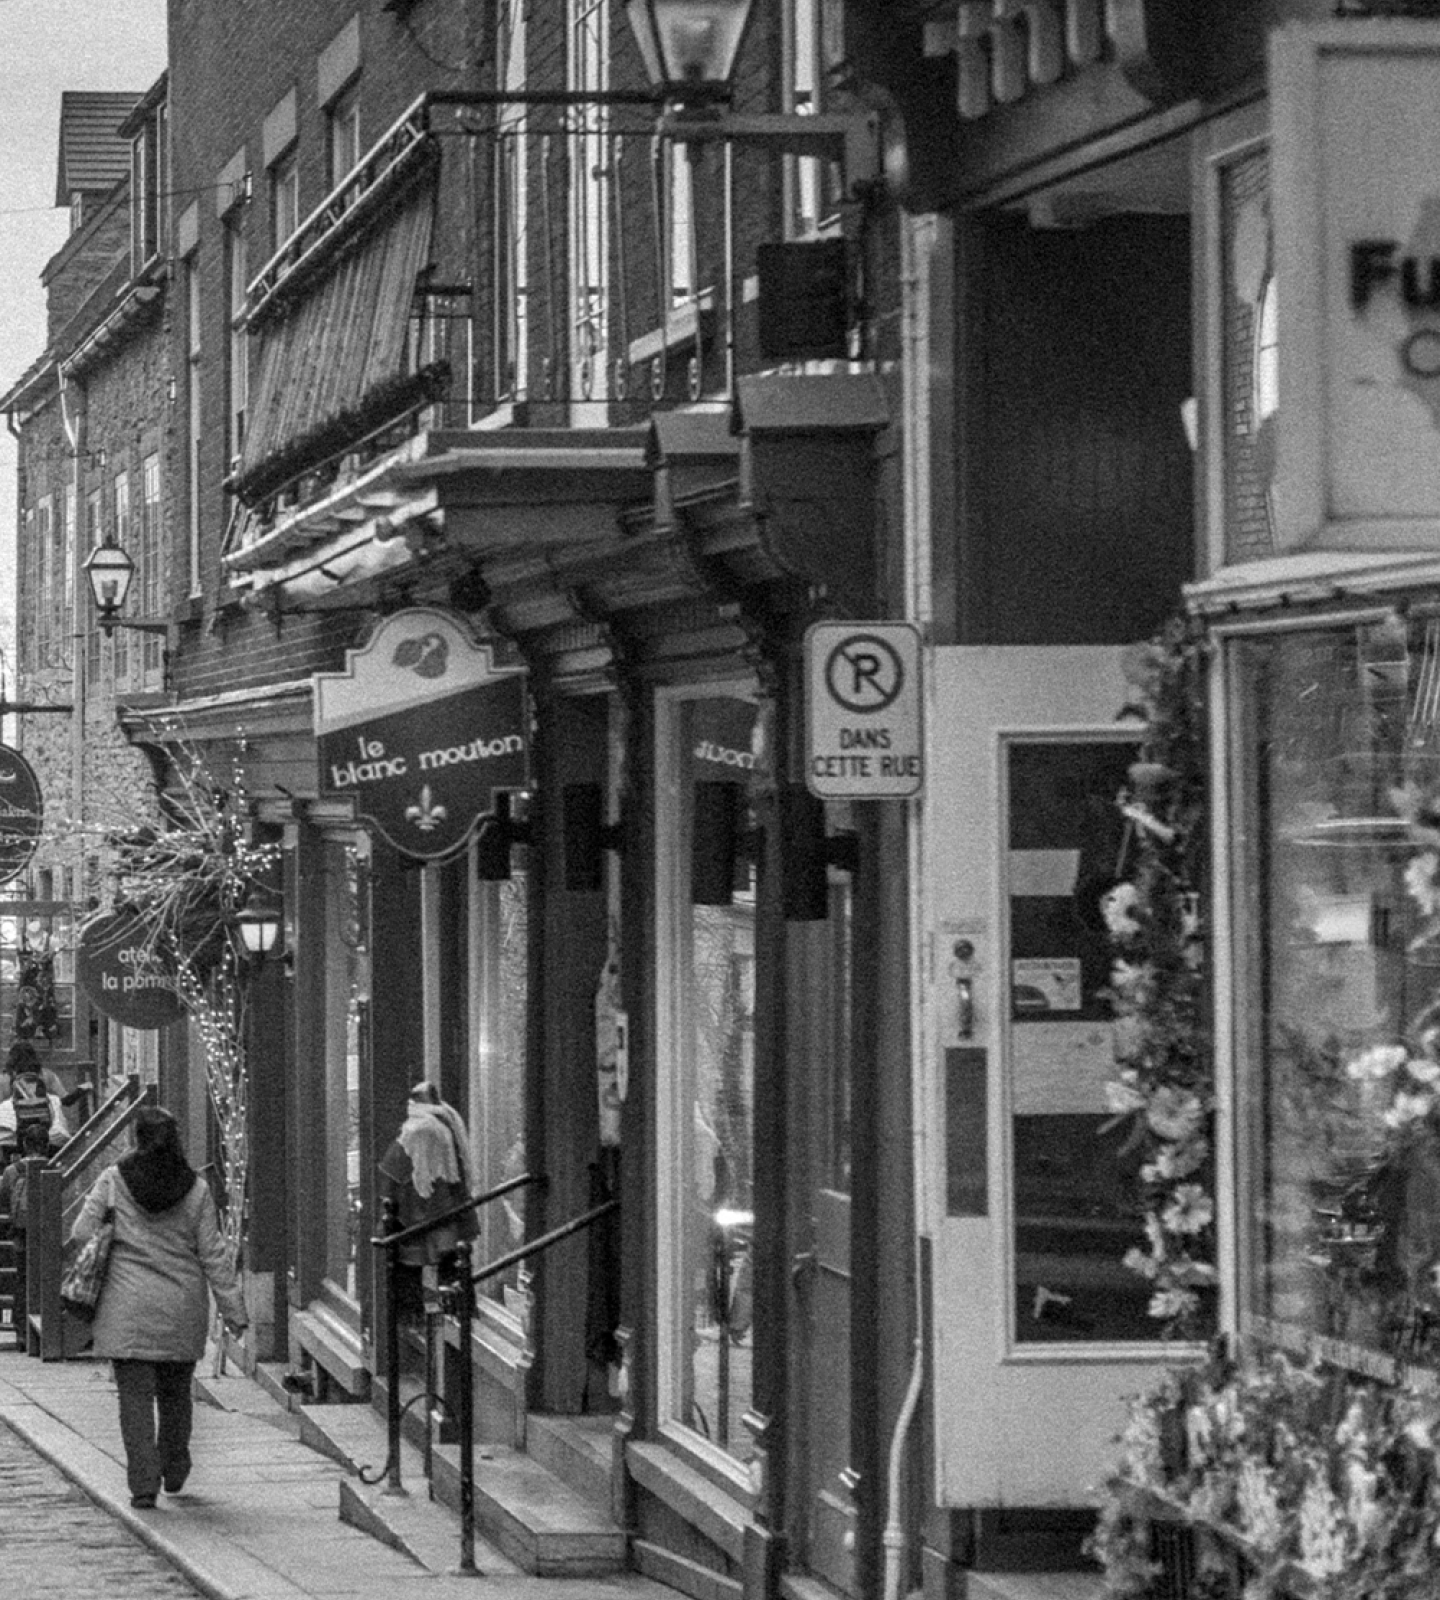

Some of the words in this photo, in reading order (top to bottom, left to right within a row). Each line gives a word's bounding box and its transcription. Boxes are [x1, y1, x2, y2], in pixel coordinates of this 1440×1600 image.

[358, 736, 385, 760] le
[839, 728, 891, 749] DANS
[331, 757, 407, 787] blanc
[419, 735, 523, 769] mouton
[812, 755, 872, 777] CETTE
[880, 755, 920, 777] RUE
[102, 972, 118, 990] la
